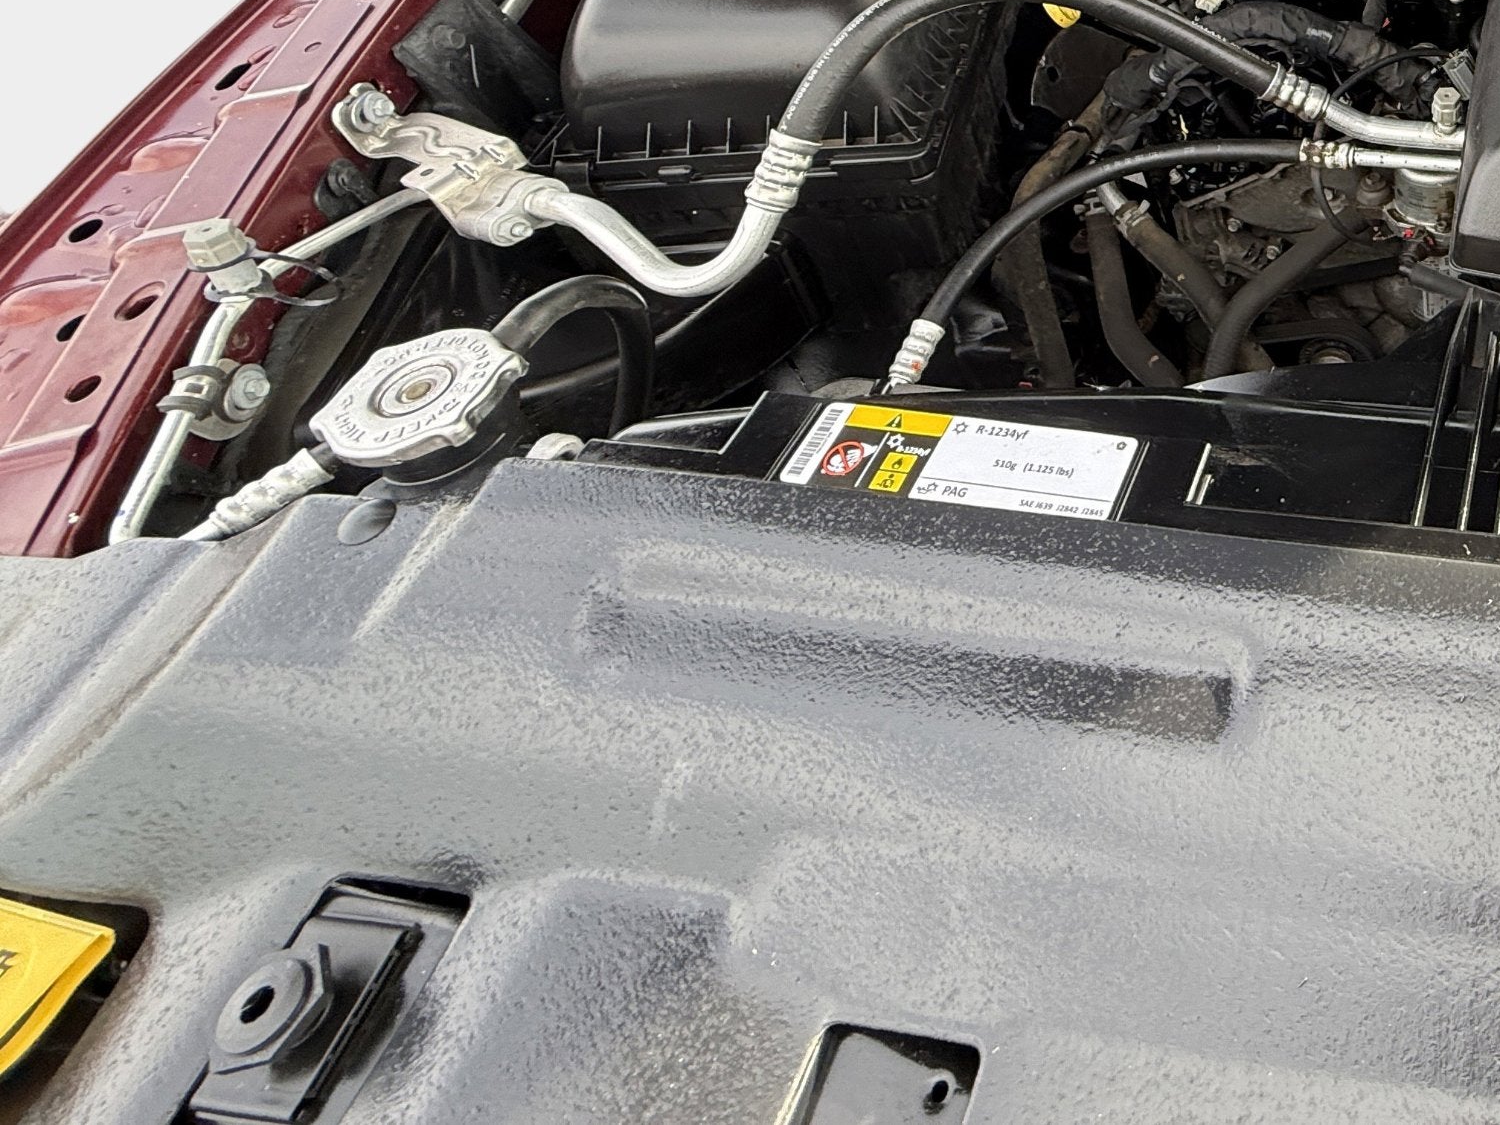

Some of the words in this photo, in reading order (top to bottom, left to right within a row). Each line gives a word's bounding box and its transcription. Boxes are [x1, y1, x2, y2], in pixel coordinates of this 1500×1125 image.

[975, 424, 1030, 441] R-1234yf
[992, 458, 1018, 472] 510g
[1022, 462, 1055, 475] (1.125
[1055, 466, 1075, 479] lbs)
[941, 485, 969, 498] PAG
[1019, 498, 1035, 509] SAE
[1035, 500, 1054, 511] J639
[1056, 503, 1079, 514] J2842
